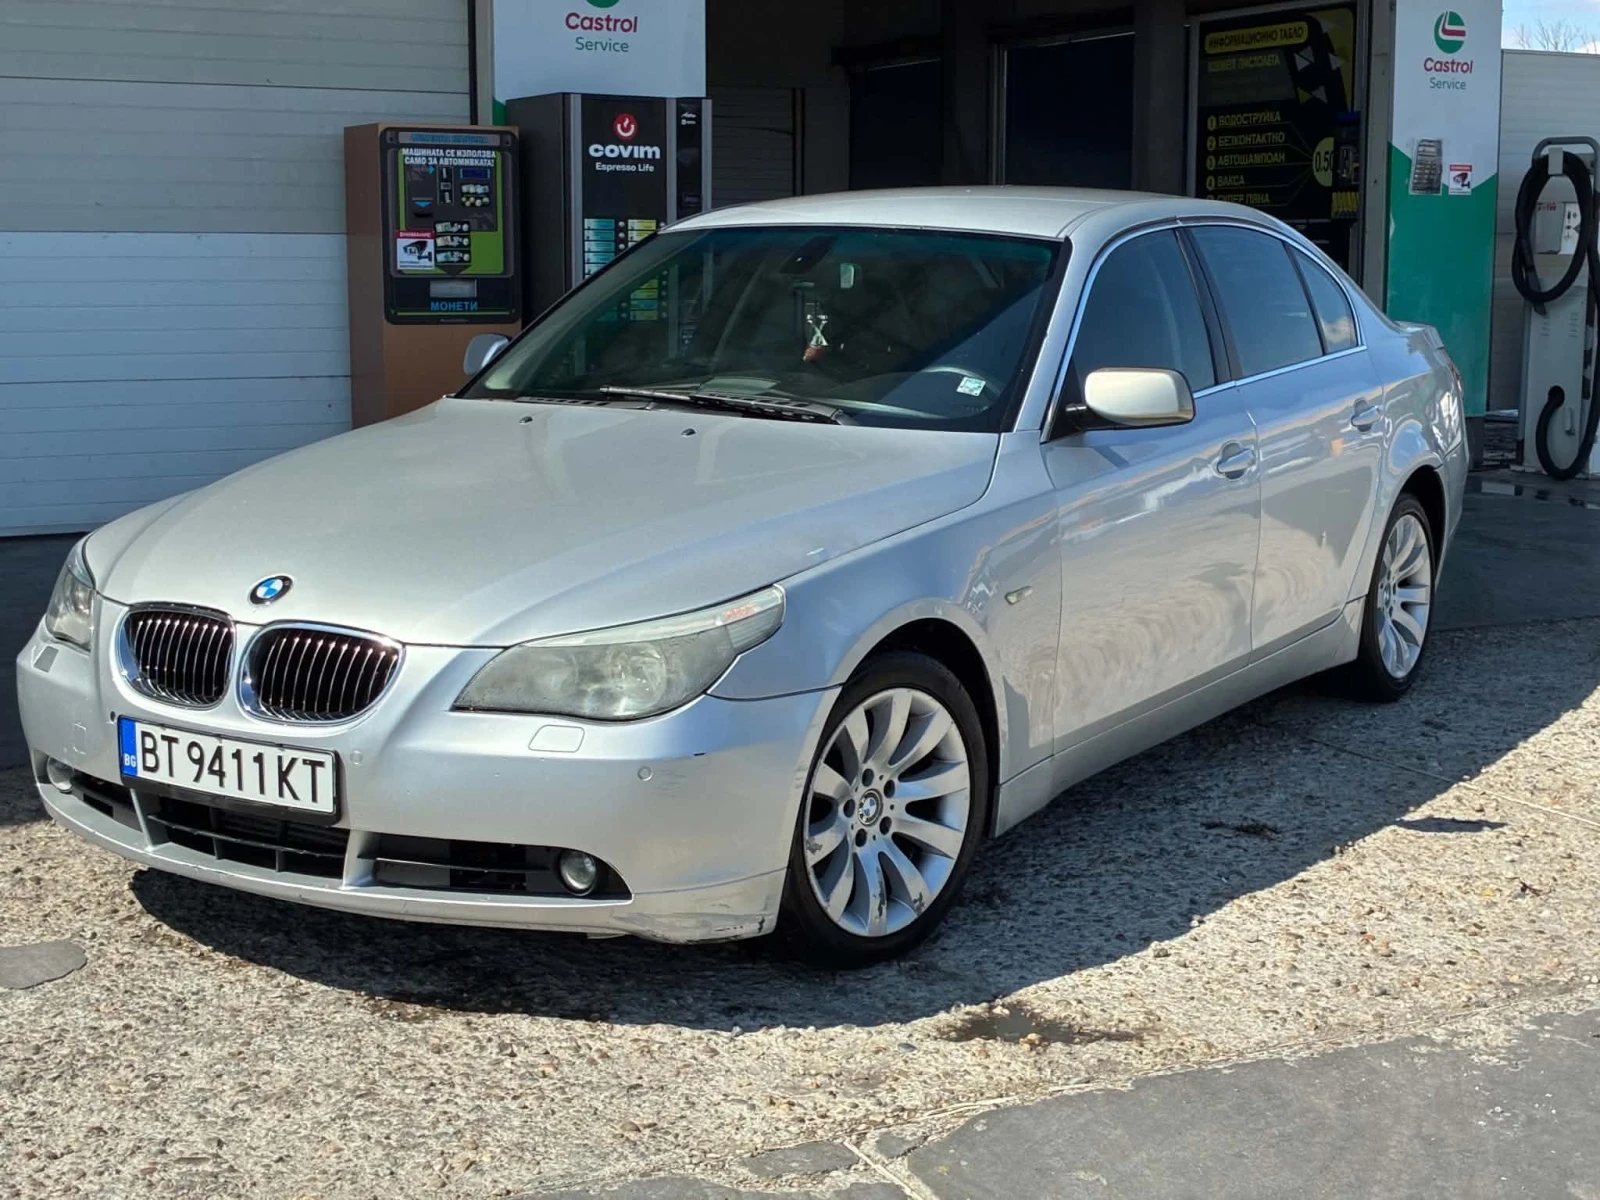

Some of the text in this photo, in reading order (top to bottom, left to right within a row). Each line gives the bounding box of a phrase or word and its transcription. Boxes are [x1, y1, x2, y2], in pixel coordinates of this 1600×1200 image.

[565, 12, 638, 33] Castrol
[575, 36, 629, 52] Service
[1423, 56, 1473, 74] Castrol
[1429, 77, 1467, 90] Service
[402, 147, 496, 159] МАШИНАТА СЕ ИЗПОЛЗВА
[404, 156, 426, 165] САМО
[427, 157, 437, 165] ЗА
[595, 162, 655, 172] Espresso Life
[1217, 175, 1244, 187] ВАКСА
[431, 301, 478, 311] МОНЕТИ
[124, 753, 137, 768] BG
[141, 730, 325, 803] BT 9411 KT
